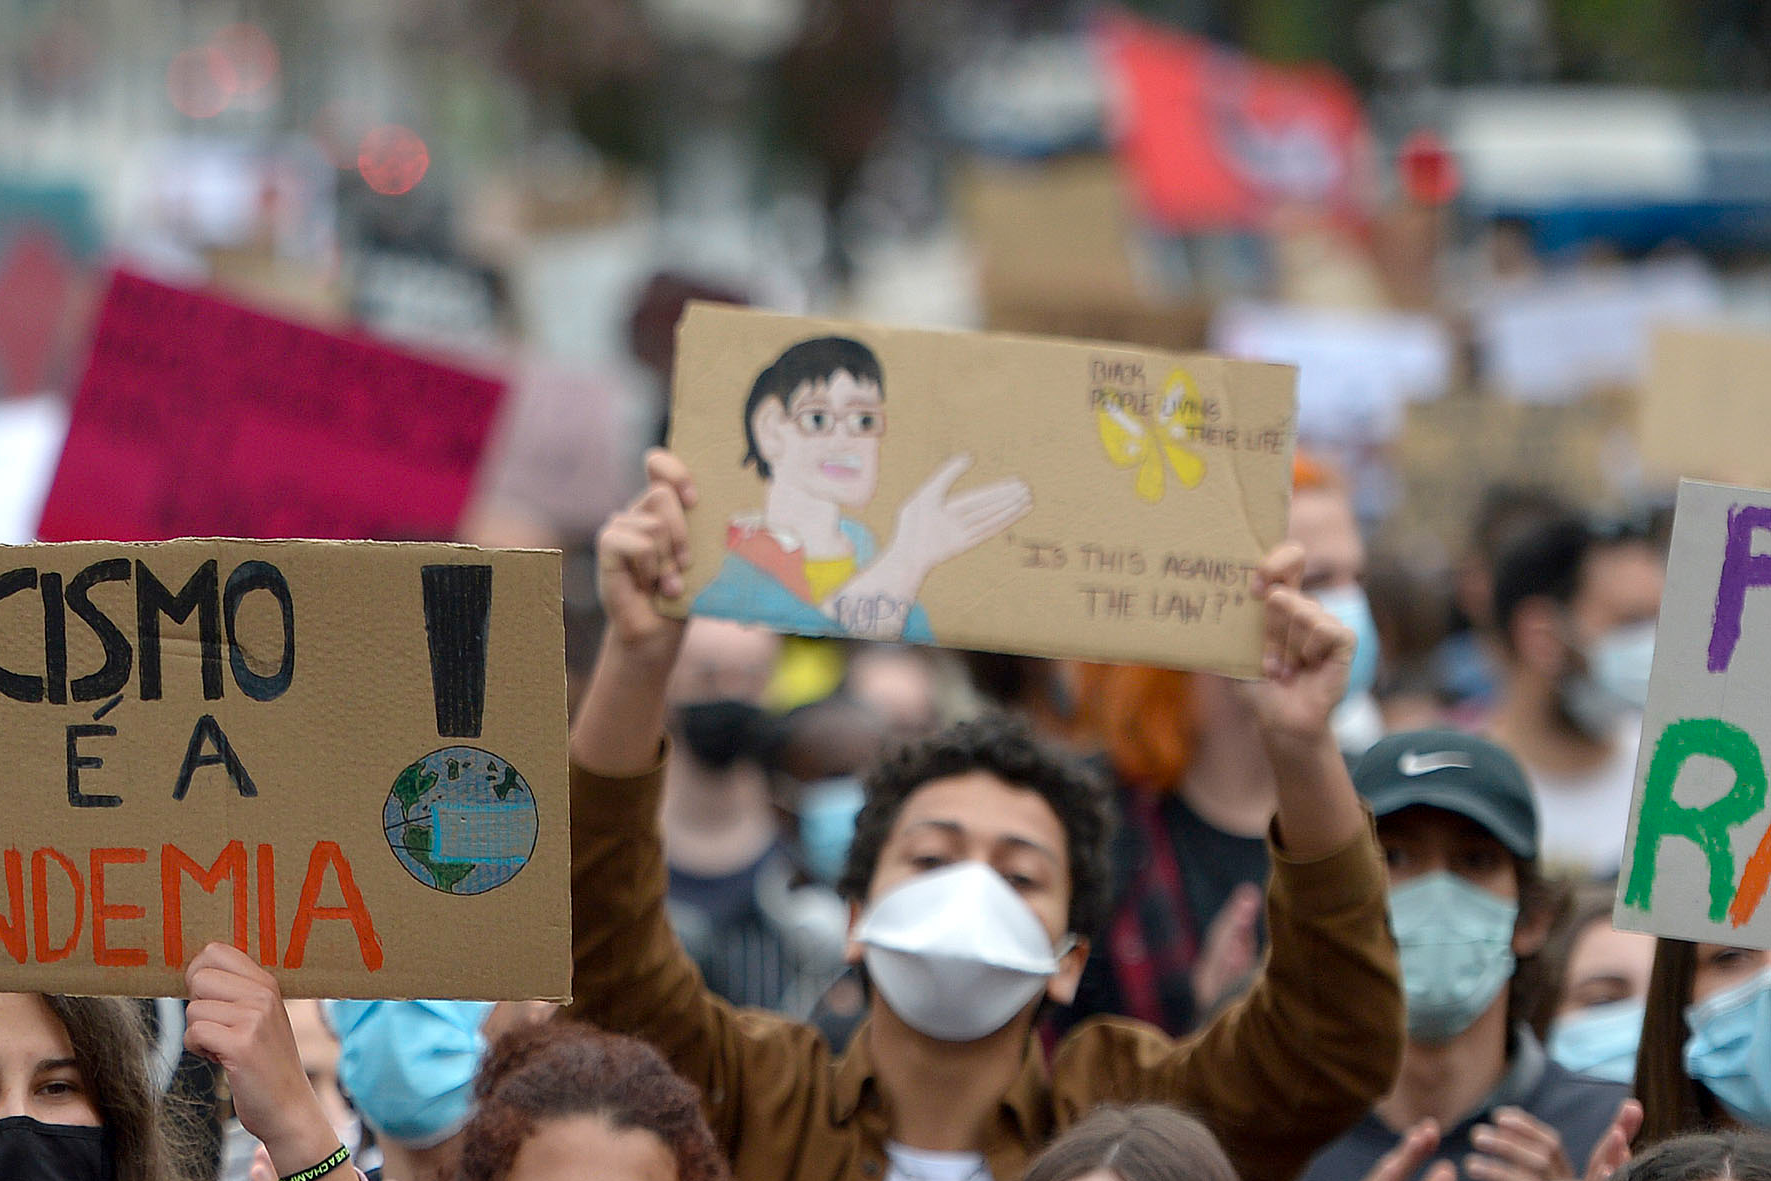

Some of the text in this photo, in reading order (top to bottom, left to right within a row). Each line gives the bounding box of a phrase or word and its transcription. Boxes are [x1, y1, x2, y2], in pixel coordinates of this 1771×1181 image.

[1079, 543, 1147, 576] THIS
[1164, 552, 1259, 586] AGAINST
[1079, 586, 1138, 619] THE
[66, 693, 259, 808] É A
[1625, 717, 1771, 928] R
